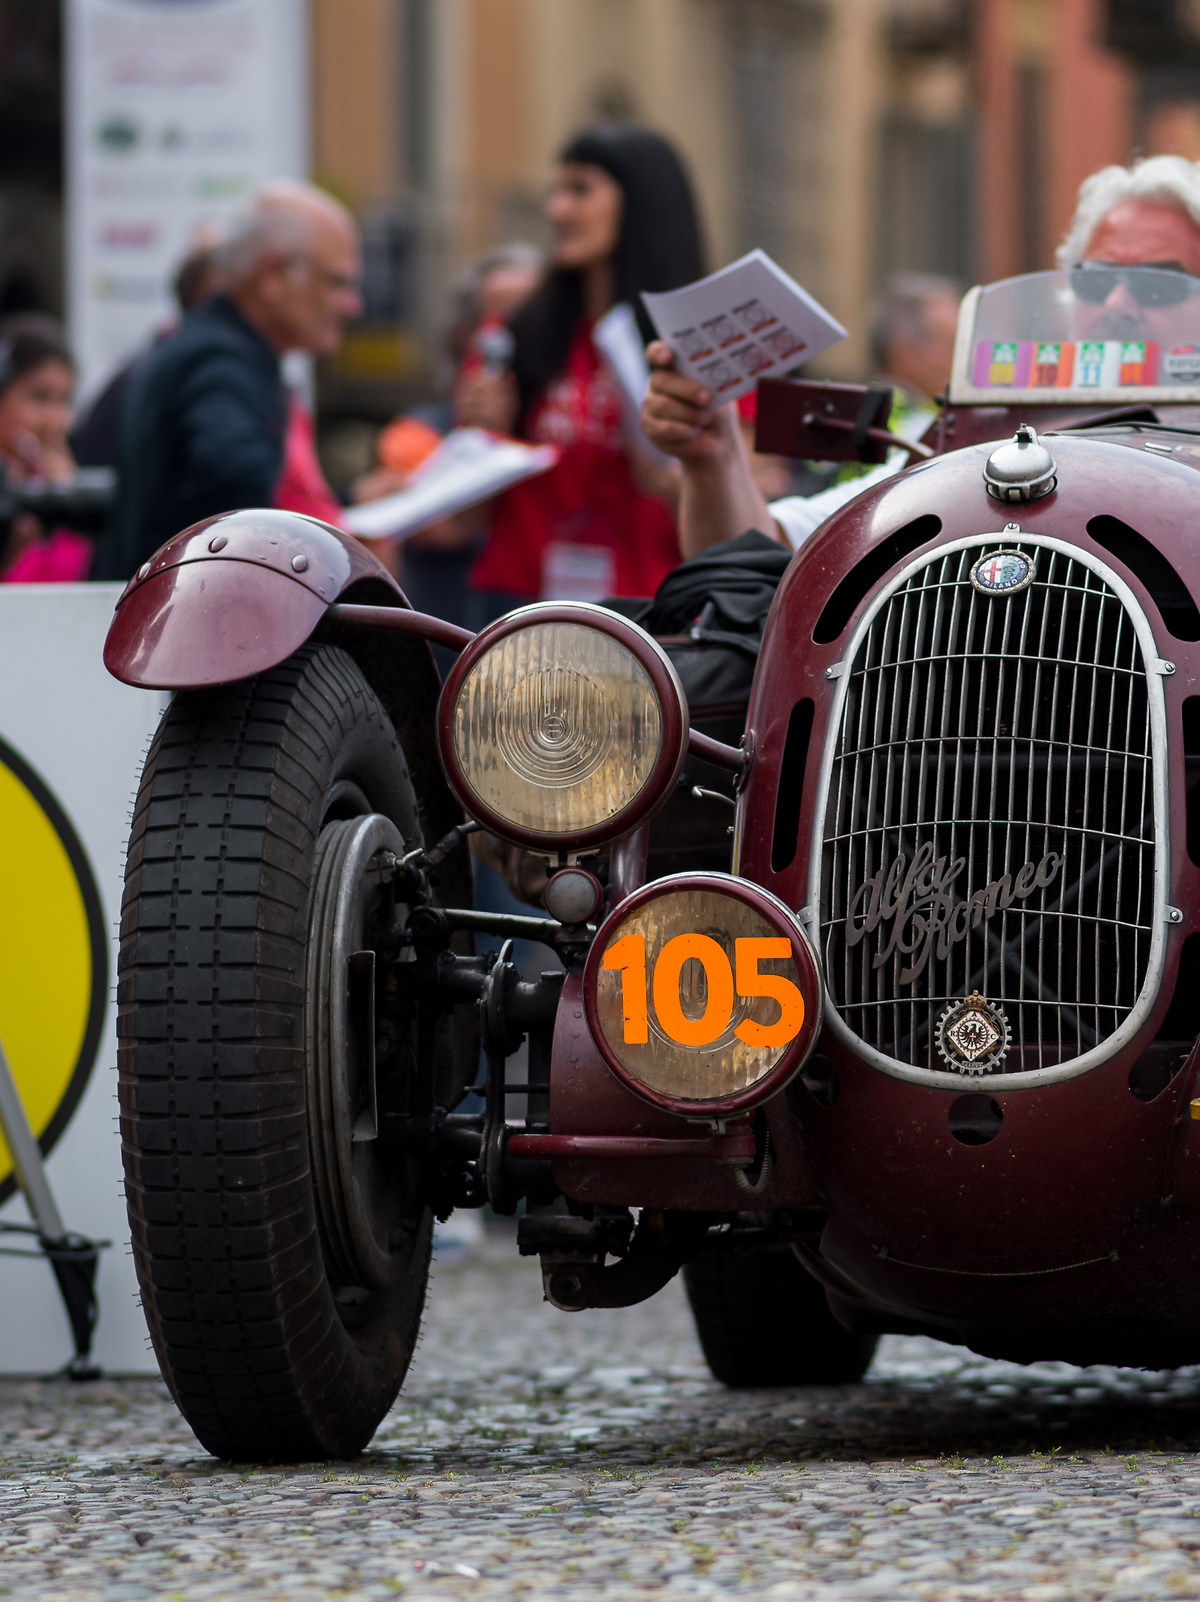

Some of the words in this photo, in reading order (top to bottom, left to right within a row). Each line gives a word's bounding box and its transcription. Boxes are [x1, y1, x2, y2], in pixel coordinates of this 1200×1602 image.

[983, 578, 1018, 589] MILANO
[897, 851, 1065, 985] Romeo
[603, 932, 805, 1049] 105
